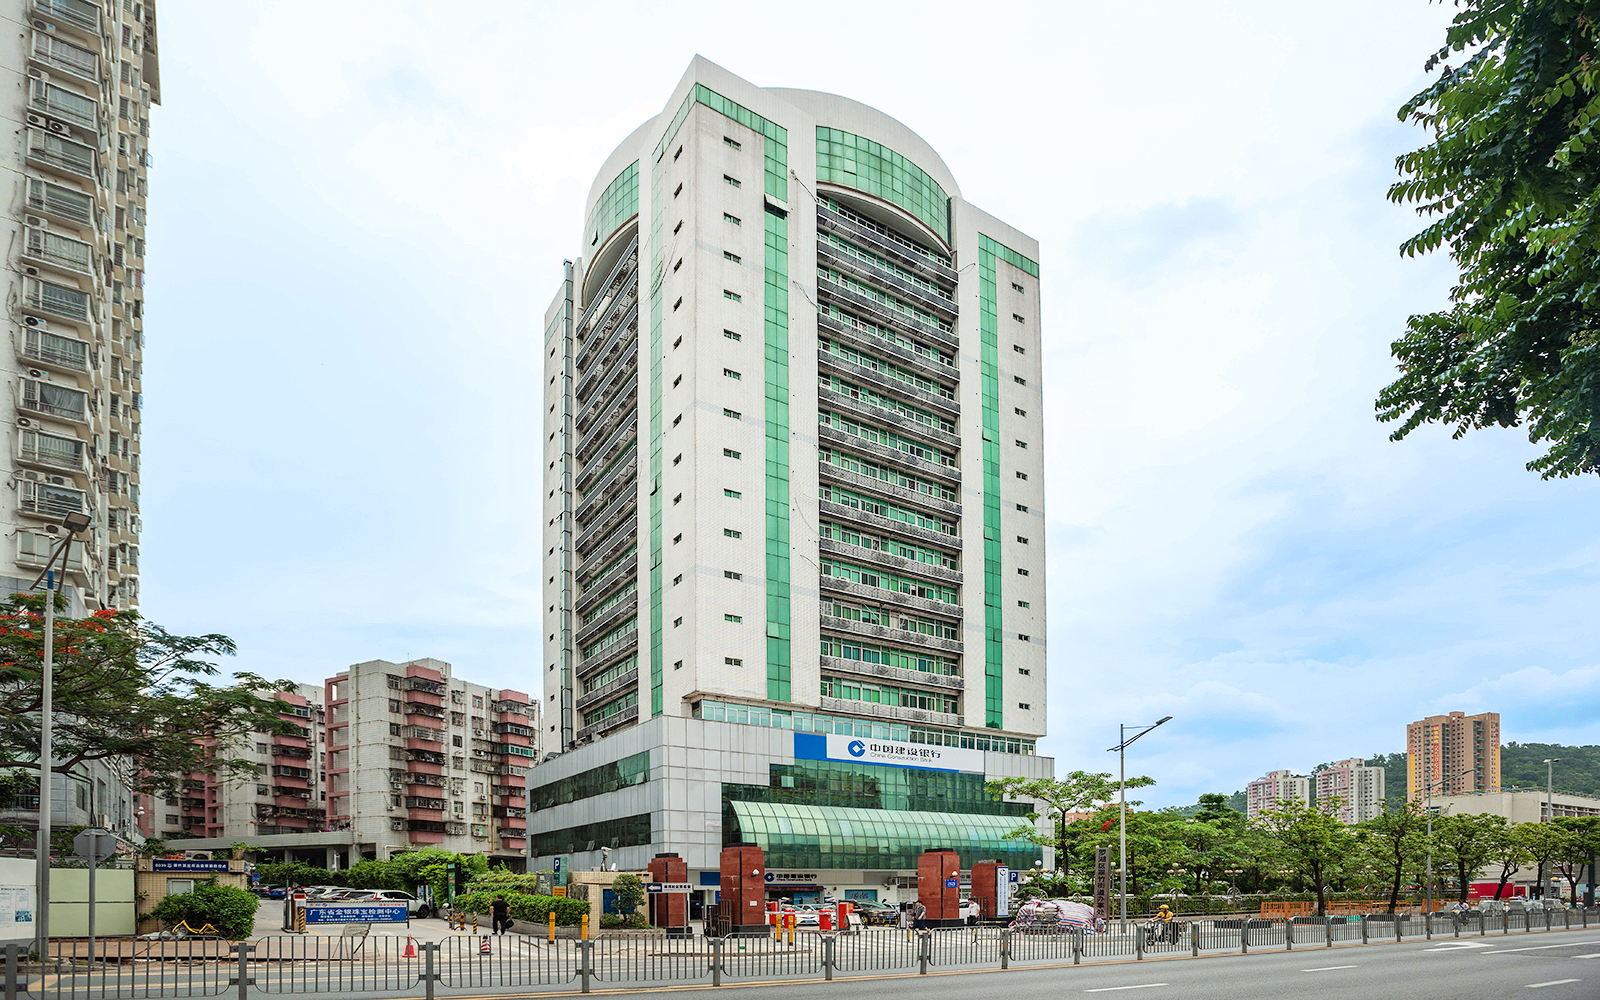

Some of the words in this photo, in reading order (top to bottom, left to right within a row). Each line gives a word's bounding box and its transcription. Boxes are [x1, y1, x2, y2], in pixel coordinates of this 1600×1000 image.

[870, 744, 941, 758] 中国建设银行
[554, 859, 560, 870] P
[1010, 872, 1017, 881] P
[309, 908, 401, 916] 广东省金银珠宝检测中心
